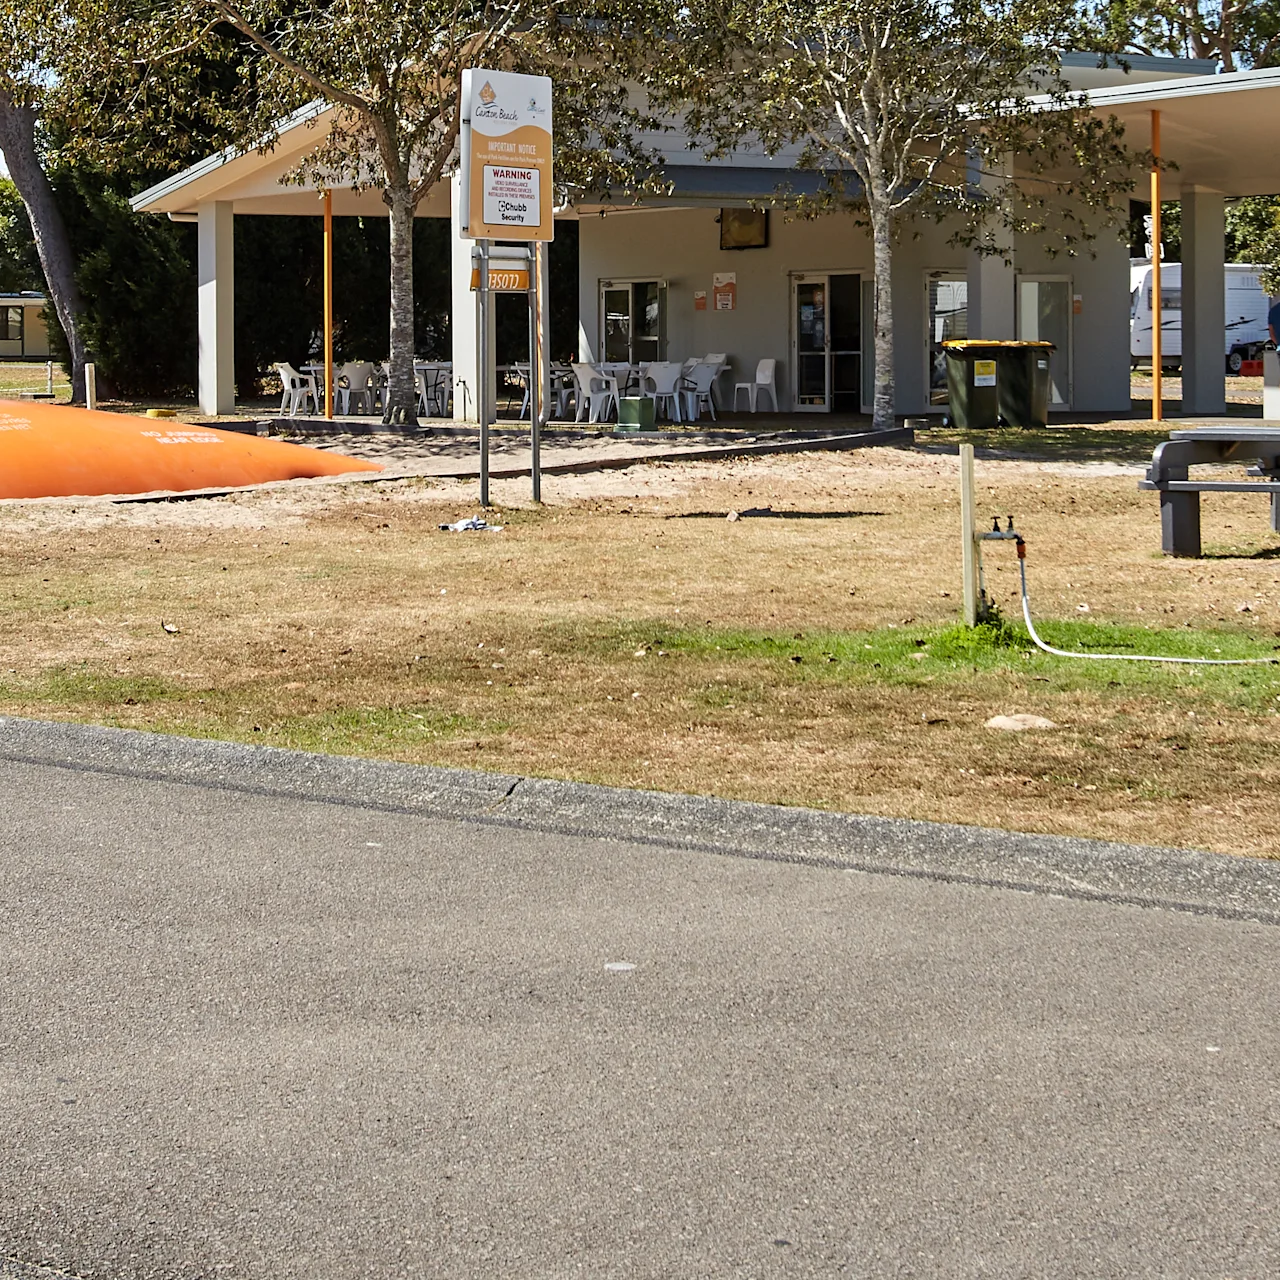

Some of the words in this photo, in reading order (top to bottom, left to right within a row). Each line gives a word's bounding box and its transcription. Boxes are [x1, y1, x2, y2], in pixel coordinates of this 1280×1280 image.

[499, 108, 519, 120] Beach
[488, 141, 516, 153] IMPORTANT
[518, 144, 536, 155] NOTICE
[493, 169, 532, 180] WARNING
[505, 202, 527, 211] Chubb
[501, 213, 524, 223] Security
